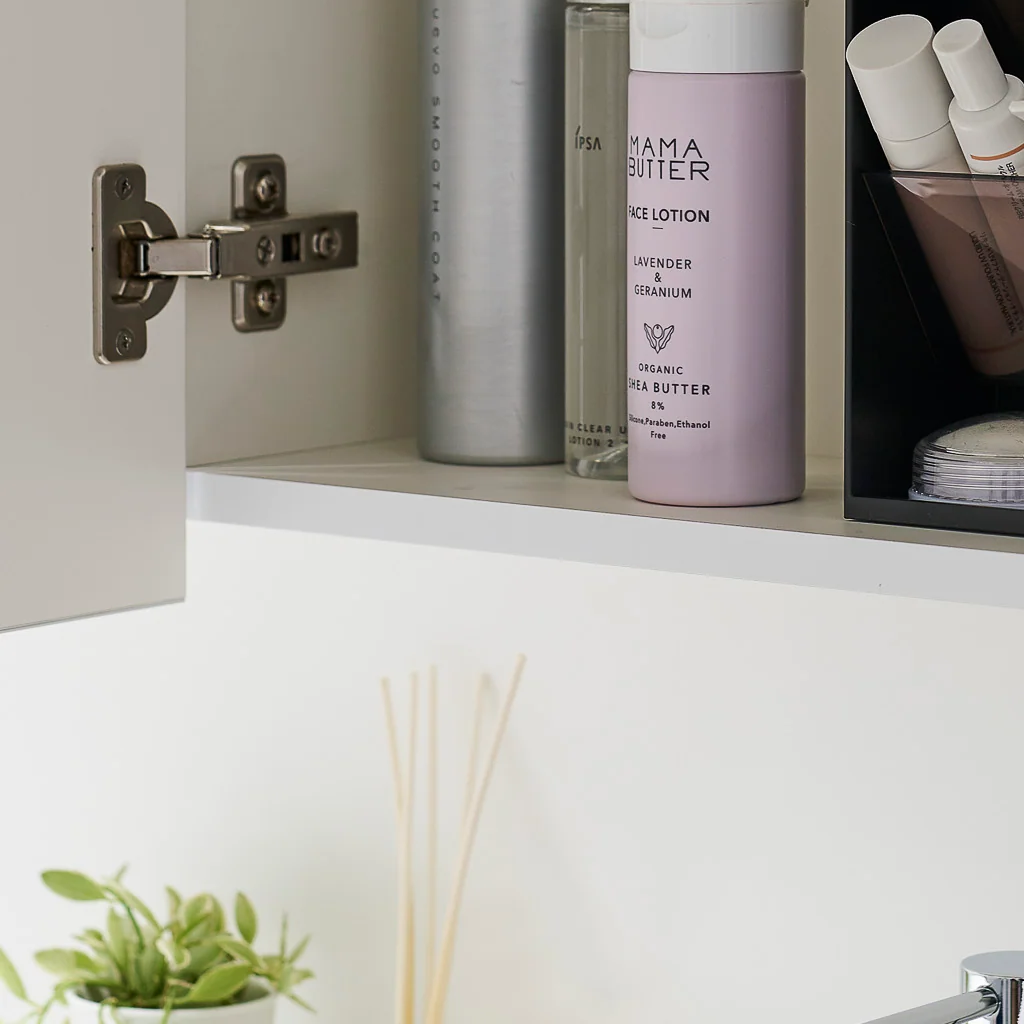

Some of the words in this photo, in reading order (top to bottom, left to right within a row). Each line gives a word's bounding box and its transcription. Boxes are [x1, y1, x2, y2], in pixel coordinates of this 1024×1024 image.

[431, 96, 440, 212] SMOOTH
[630, 135, 703, 159] MAMA
[629, 157, 710, 181] BUTTER
[629, 205, 649, 220] FACE
[652, 208, 710, 222] LOTION
[634, 256, 692, 270] LAVENDER
[654, 272, 662, 283] &
[634, 284, 692, 298] GERANIUM
[638, 362, 684, 375] ORGANIC
[628, 377, 649, 392] SHEA
[653, 382, 710, 395] BUTTER
[651, 400, 665, 411] 8%
[577, 422, 611, 433] CLEAR
[619, 425, 628, 434] U
[650, 430, 667, 440] Free
[607, 438, 614, 448] 2
